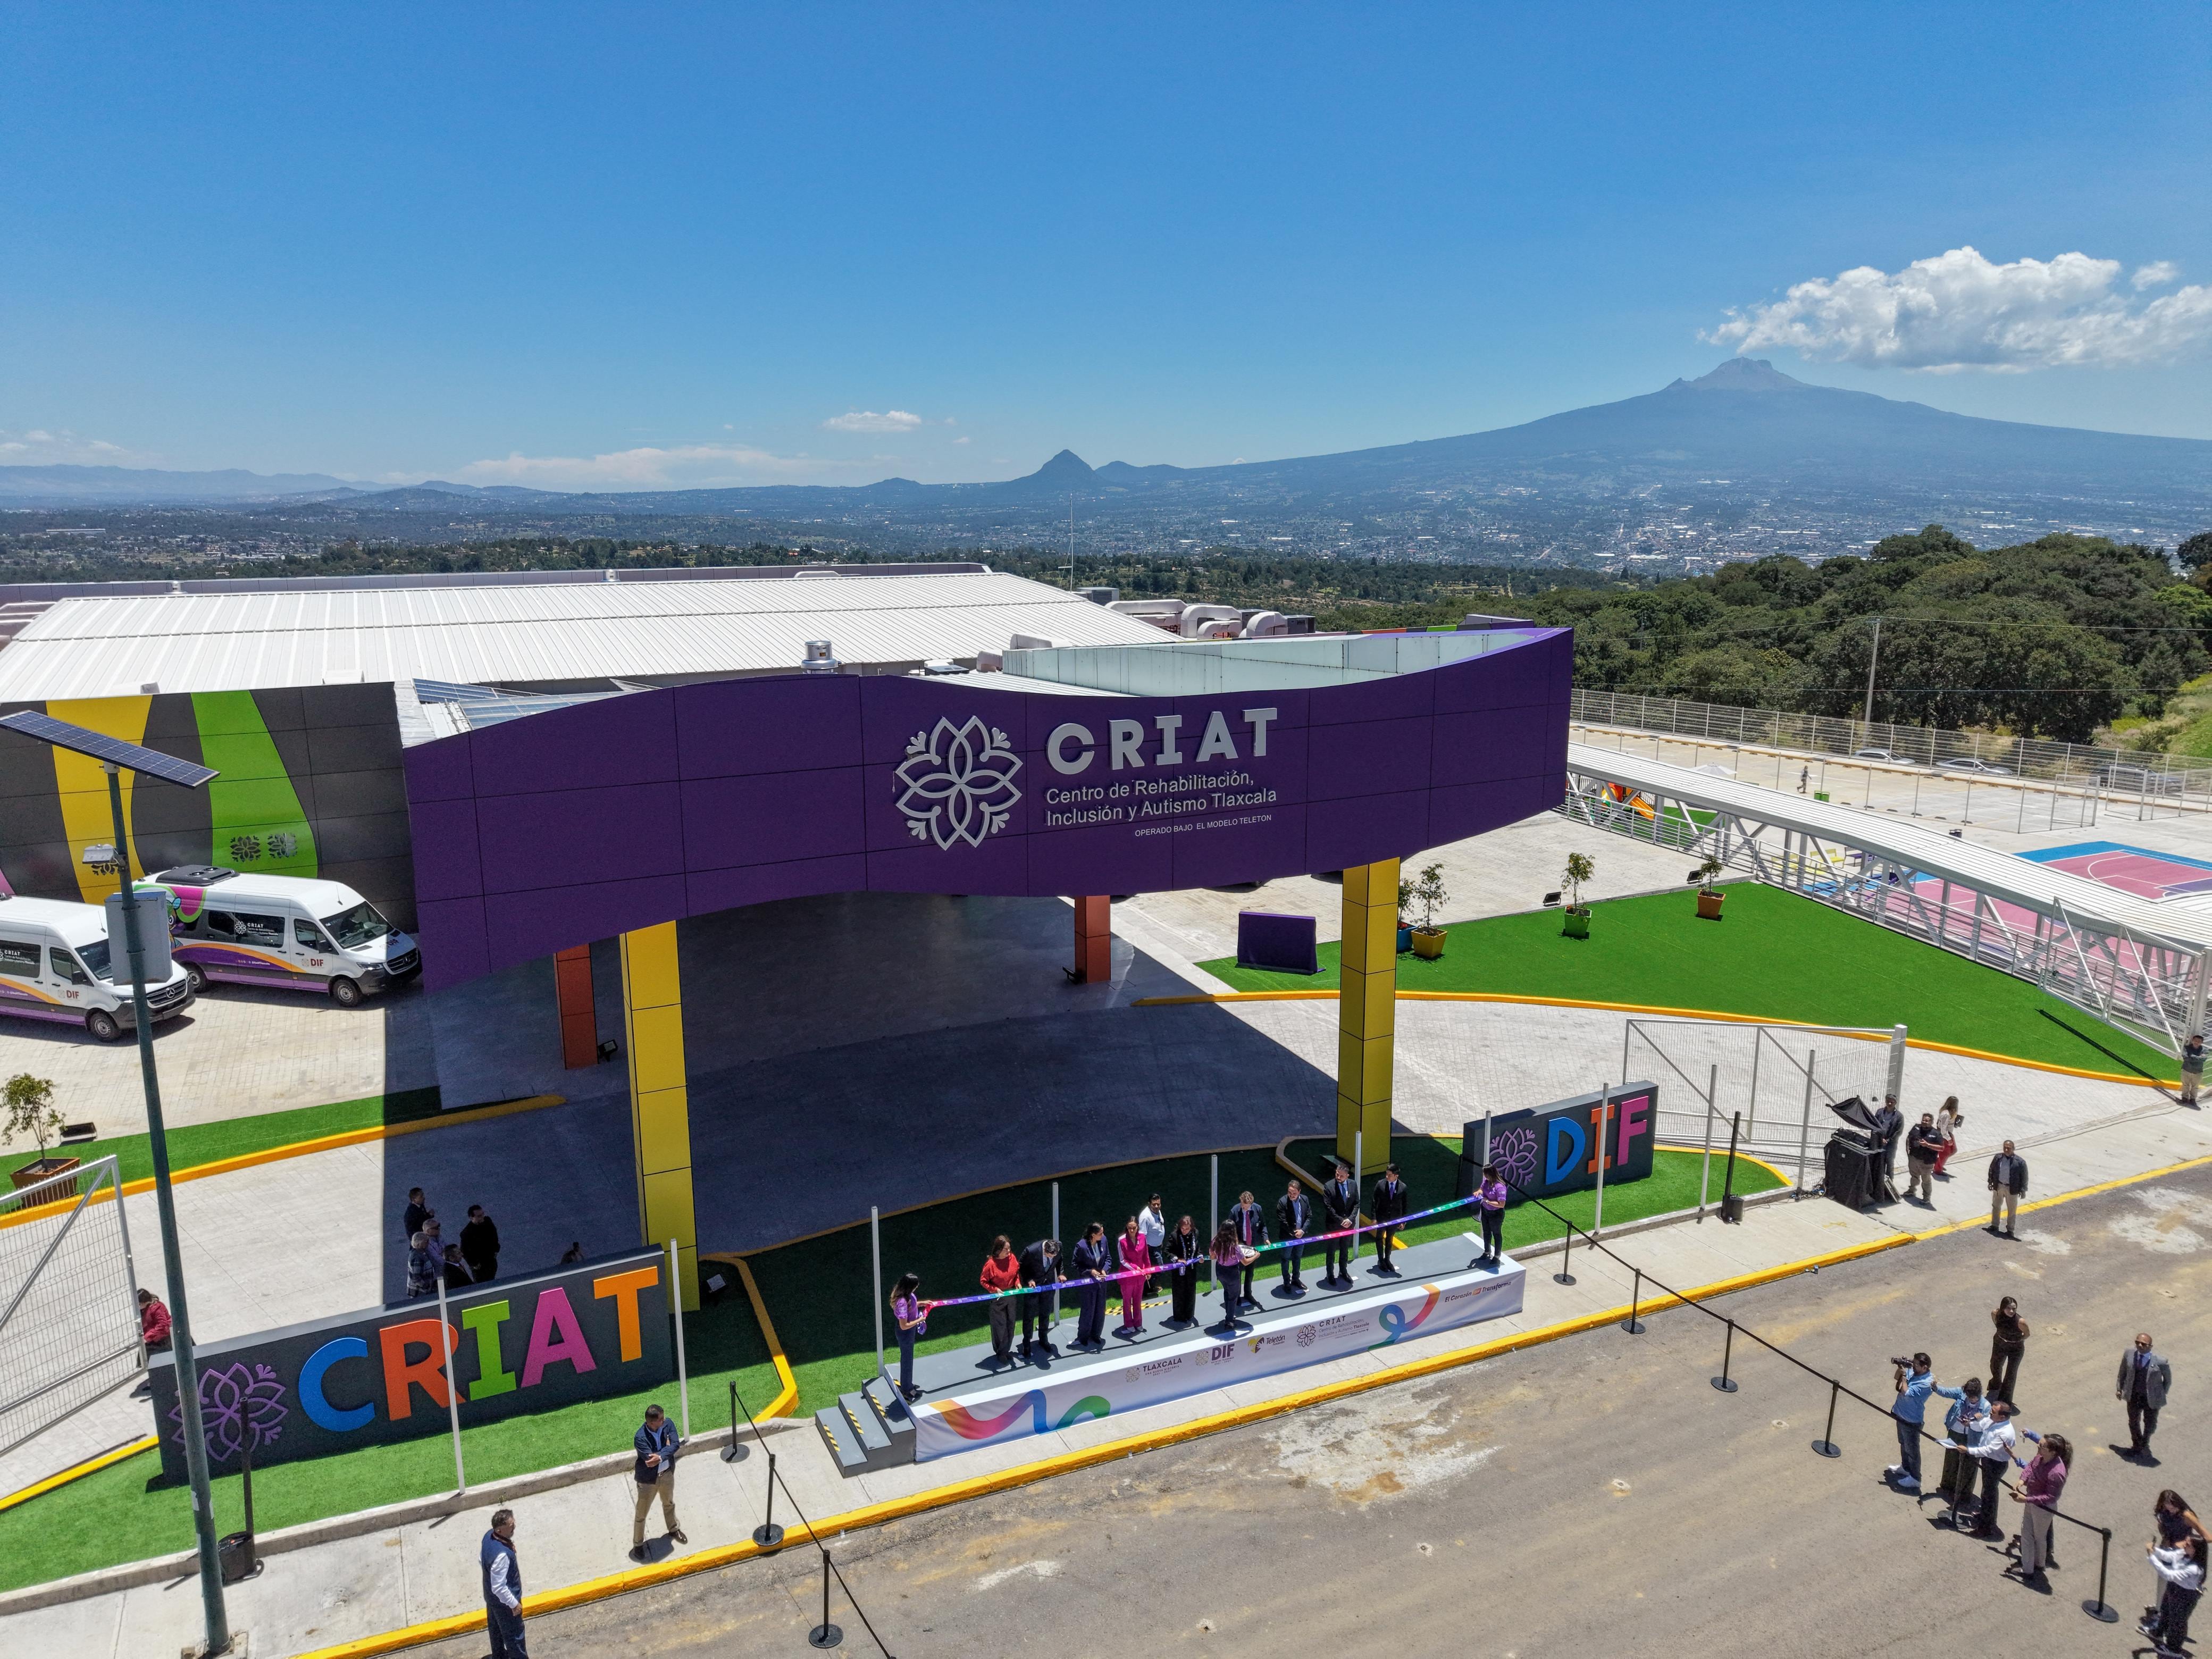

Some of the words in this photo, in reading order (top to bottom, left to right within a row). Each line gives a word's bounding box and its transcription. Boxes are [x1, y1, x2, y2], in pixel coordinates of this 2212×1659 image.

[1048, 707, 1277, 775] CRIAT
[1046, 786, 1104, 804] Centro
[1109, 782, 1129, 798] de
[1134, 771, 1254, 795] Rehabilitación,
[1048, 805, 1122, 826] Inclusión
[1128, 805, 1137, 822] y
[1141, 798, 1207, 816] Autismo
[1211, 787, 1277, 808] Tlaxcala
[1135, 826, 1172, 837] OPERADO
[1174, 824, 1193, 833] BAJO
[1207, 819, 1238, 828] MODELO
[1239, 814, 1272, 824] TELETON
[311, 958, 324, 967] DIF
[66, 990, 79, 999] DIF
[1545, 1095, 1649, 1185] DIF
[1482, 1281, 1512, 1293] Transforma
[1451, 1291, 1472, 1301] Corazón
[1319, 1316, 1346, 1327] CRIAT
[1267, 1334, 1285, 1345] Teletón
[298, 1266, 659, 1432] CRIAT
[1212, 1343, 1235, 1361] DIF
[1143, 1357, 1182, 1372] TLAXCALA
